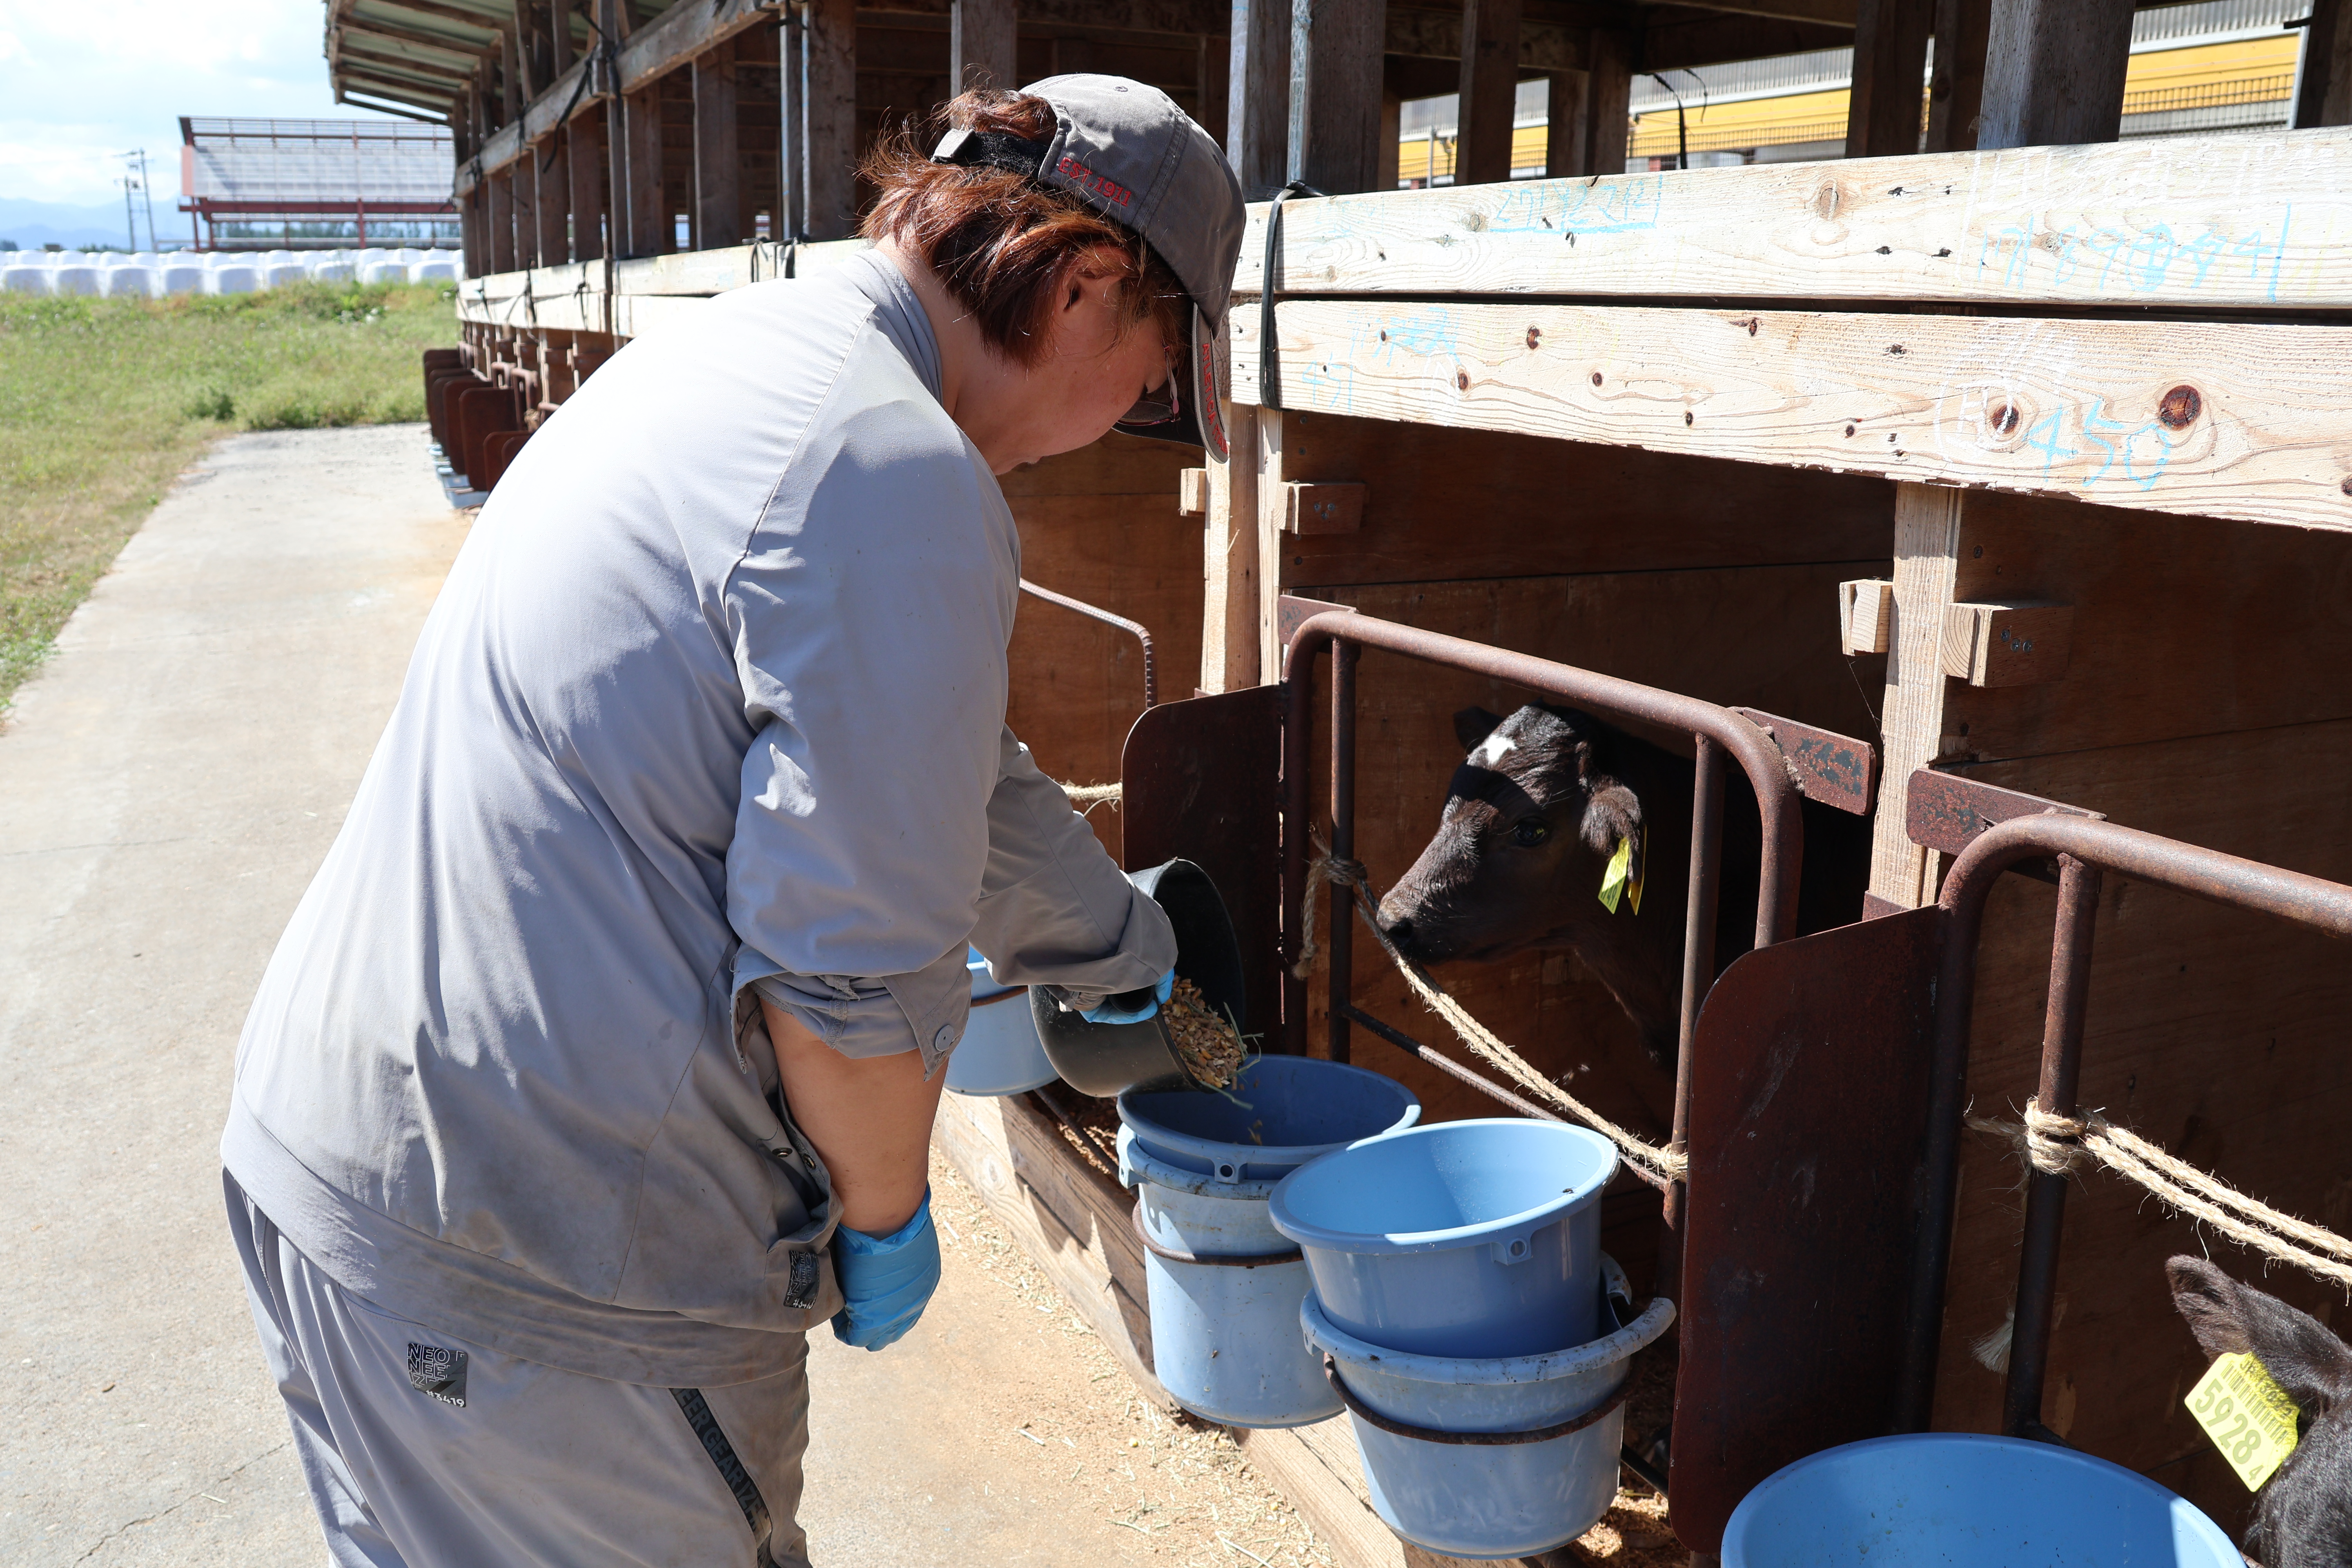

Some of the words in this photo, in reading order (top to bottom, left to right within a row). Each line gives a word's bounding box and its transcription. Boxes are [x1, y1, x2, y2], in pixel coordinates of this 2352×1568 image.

[1058, 157, 1132, 207] EST.1911
[1202, 343, 1217, 426] ATLETICA
[2023, 395, 2173, 492] 450
[407, 1343, 450, 1365] NEO
[407, 1357, 450, 1379] NEE
[425, 1390, 465, 1408] #3419
[702, 1426, 745, 1490] GEAR
[2195, 1379, 2261, 1465] 5928
[2249, 1464, 2264, 1482] 4
